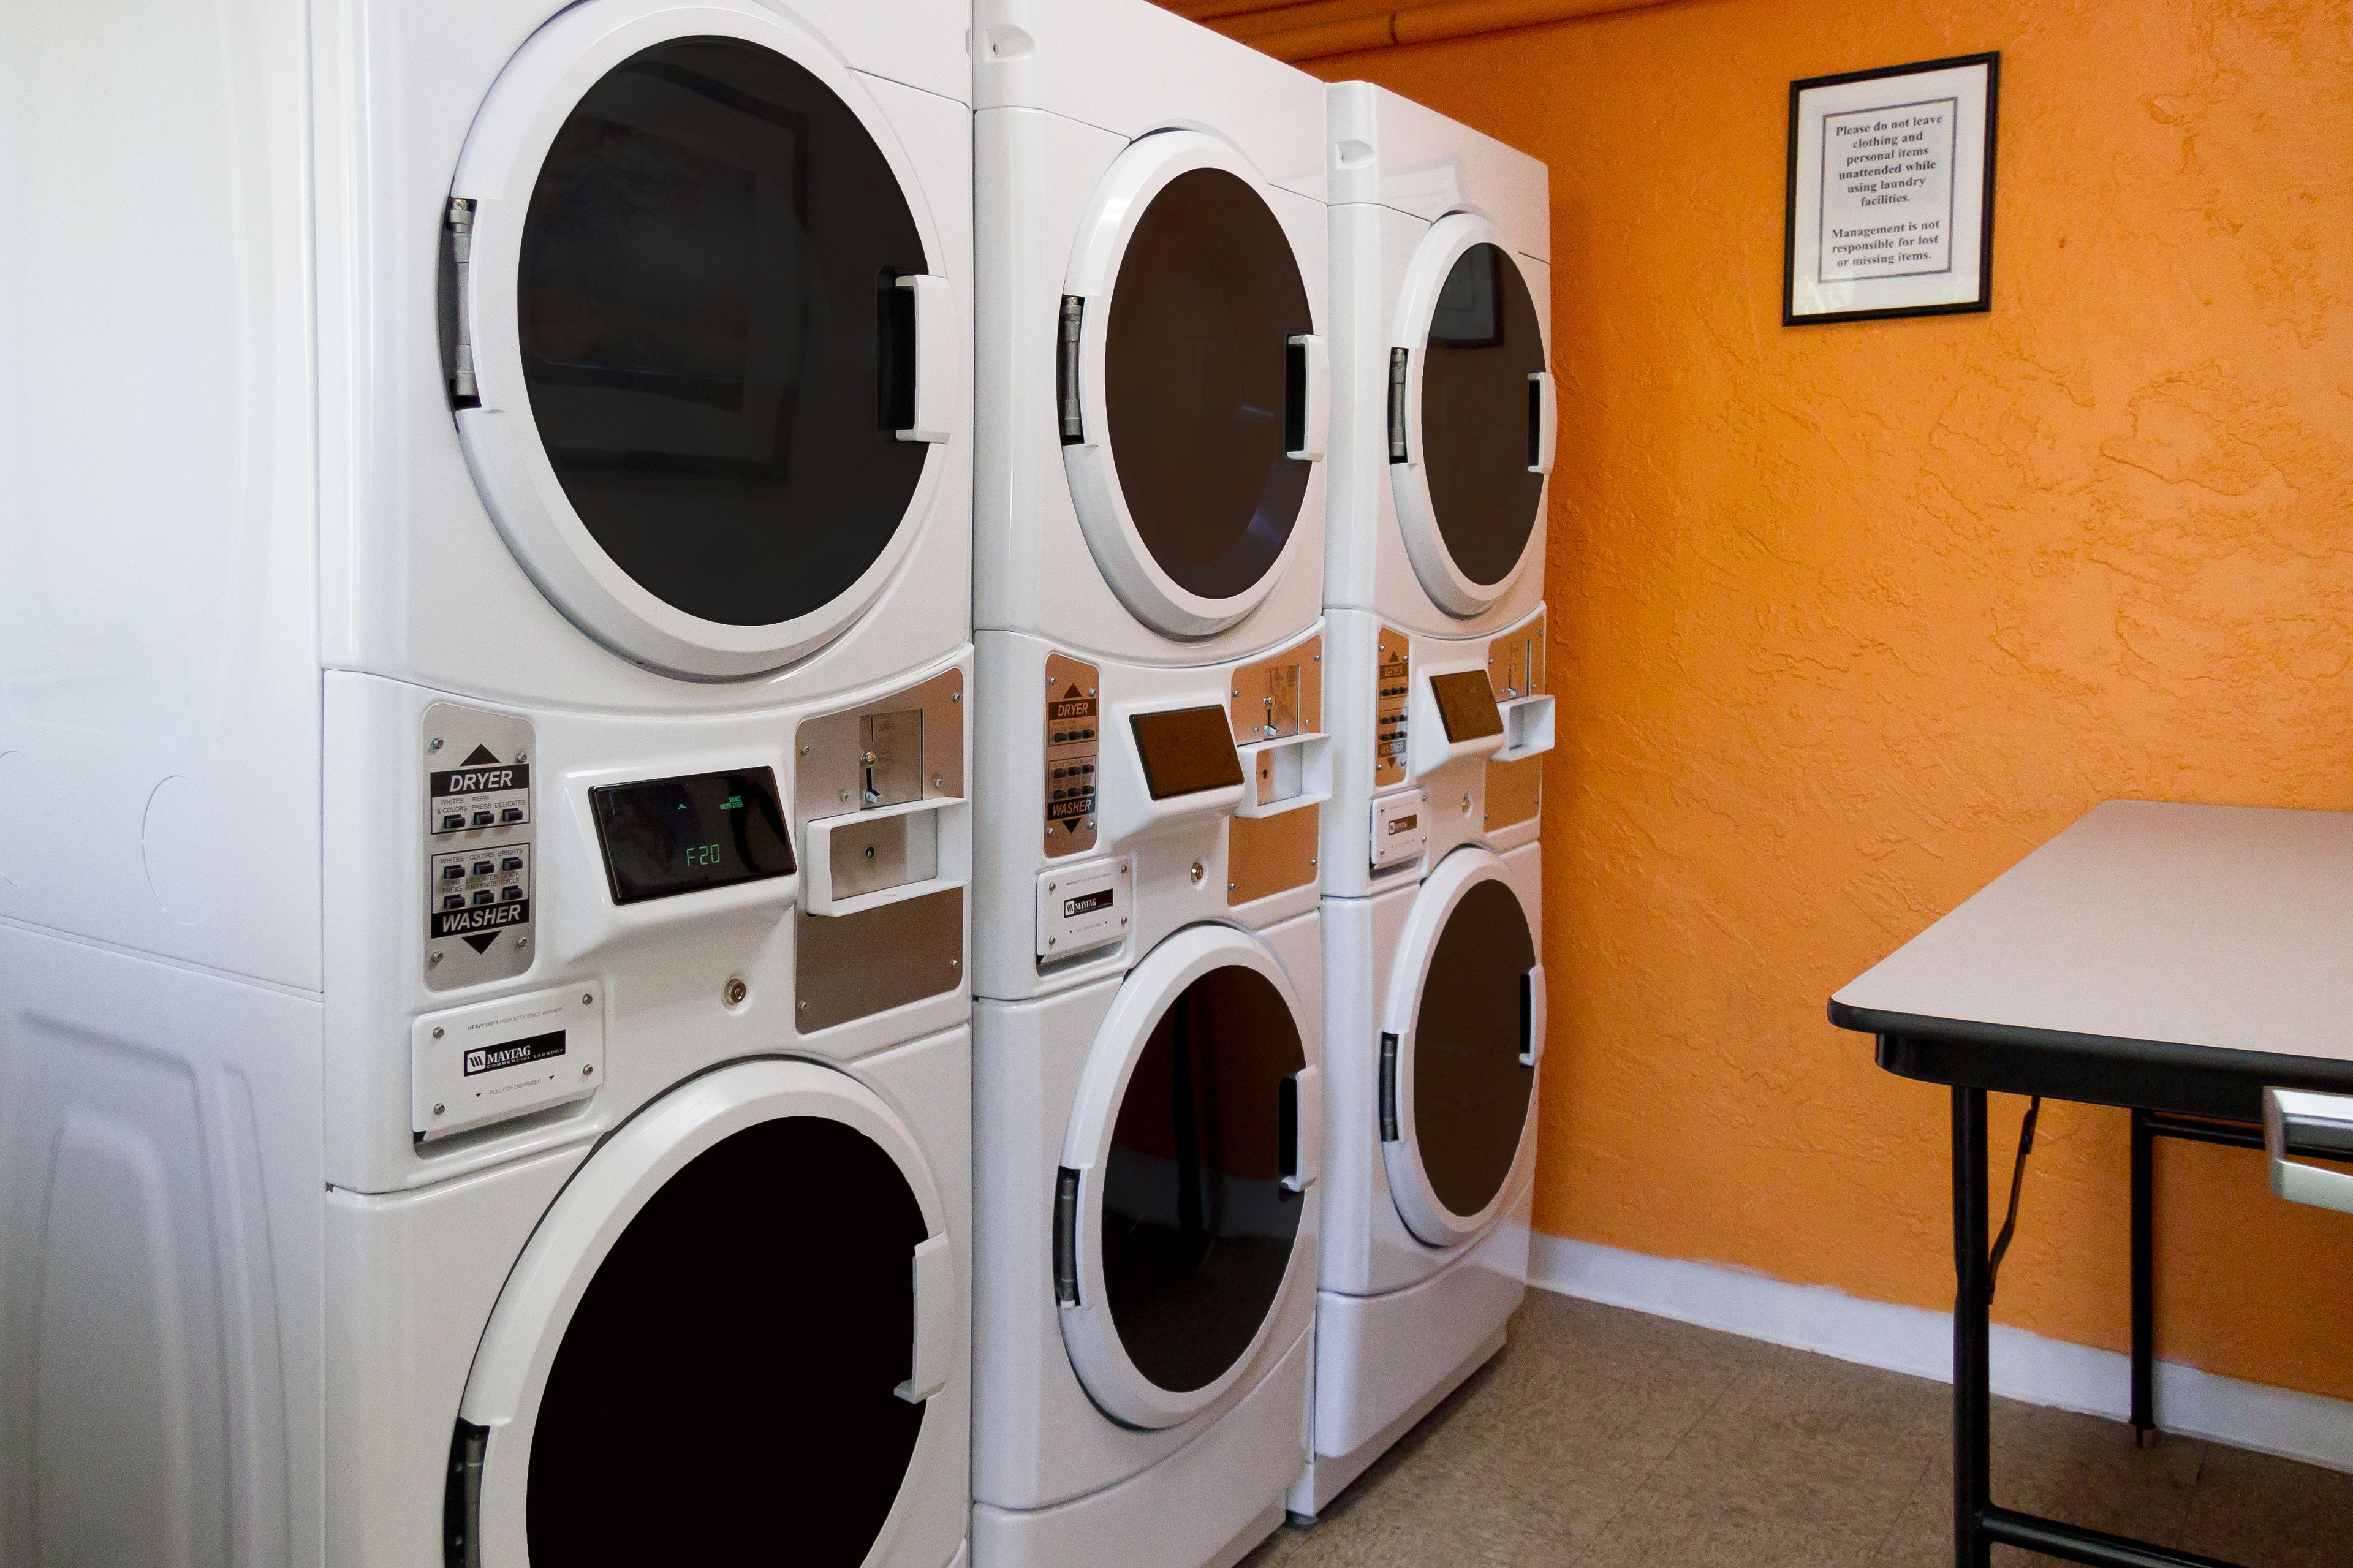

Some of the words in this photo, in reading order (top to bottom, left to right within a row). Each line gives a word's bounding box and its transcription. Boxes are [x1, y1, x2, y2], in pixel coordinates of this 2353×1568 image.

[1836, 126, 1870, 136] Please
[1873, 121, 1887, 131] do
[1891, 119, 1909, 129] not
[1913, 115, 1943, 126] leave
[1852, 135, 1898, 149] clothing
[1901, 131, 1923, 143] and
[1846, 150, 1895, 167] personal
[1898, 147, 1930, 158] items
[1838, 164, 1901, 180] unattended
[1906, 160, 1936, 172] while
[1847, 183, 1877, 194] using
[1881, 177, 1926, 189] laundry
[1861, 194, 1911, 206] facilities.
[1832, 224, 1904, 239] Management
[1908, 221, 1917, 232] is
[1920, 220, 1940, 230] not
[1832, 239, 1895, 254] responsible
[1898, 237, 1915, 248] for
[1919, 235, 1939, 245] lost
[1852, 254, 1895, 266] missing
[1898, 252, 1931, 262] items.
[1058, 702, 1088, 717] DRYER
[449, 770, 513, 792] DRYER
[494, 799, 526, 808] DELICATES
[1053, 799, 1091, 817] WASHER
[469, 852, 494, 860] COLORS
[498, 848, 523, 857] BRIGHTS
[686, 844, 721, 866] F20
[1075, 898, 1096, 911] MAYTAG
[442, 904, 521, 933] WASHER
[487, 1045, 531, 1065] MAYTAG
[487, 1056, 531, 1069] COMMERCIAL
[533, 1048, 563, 1059] LAUNDRY
[513, 1078, 542, 1090] DISPENSER
